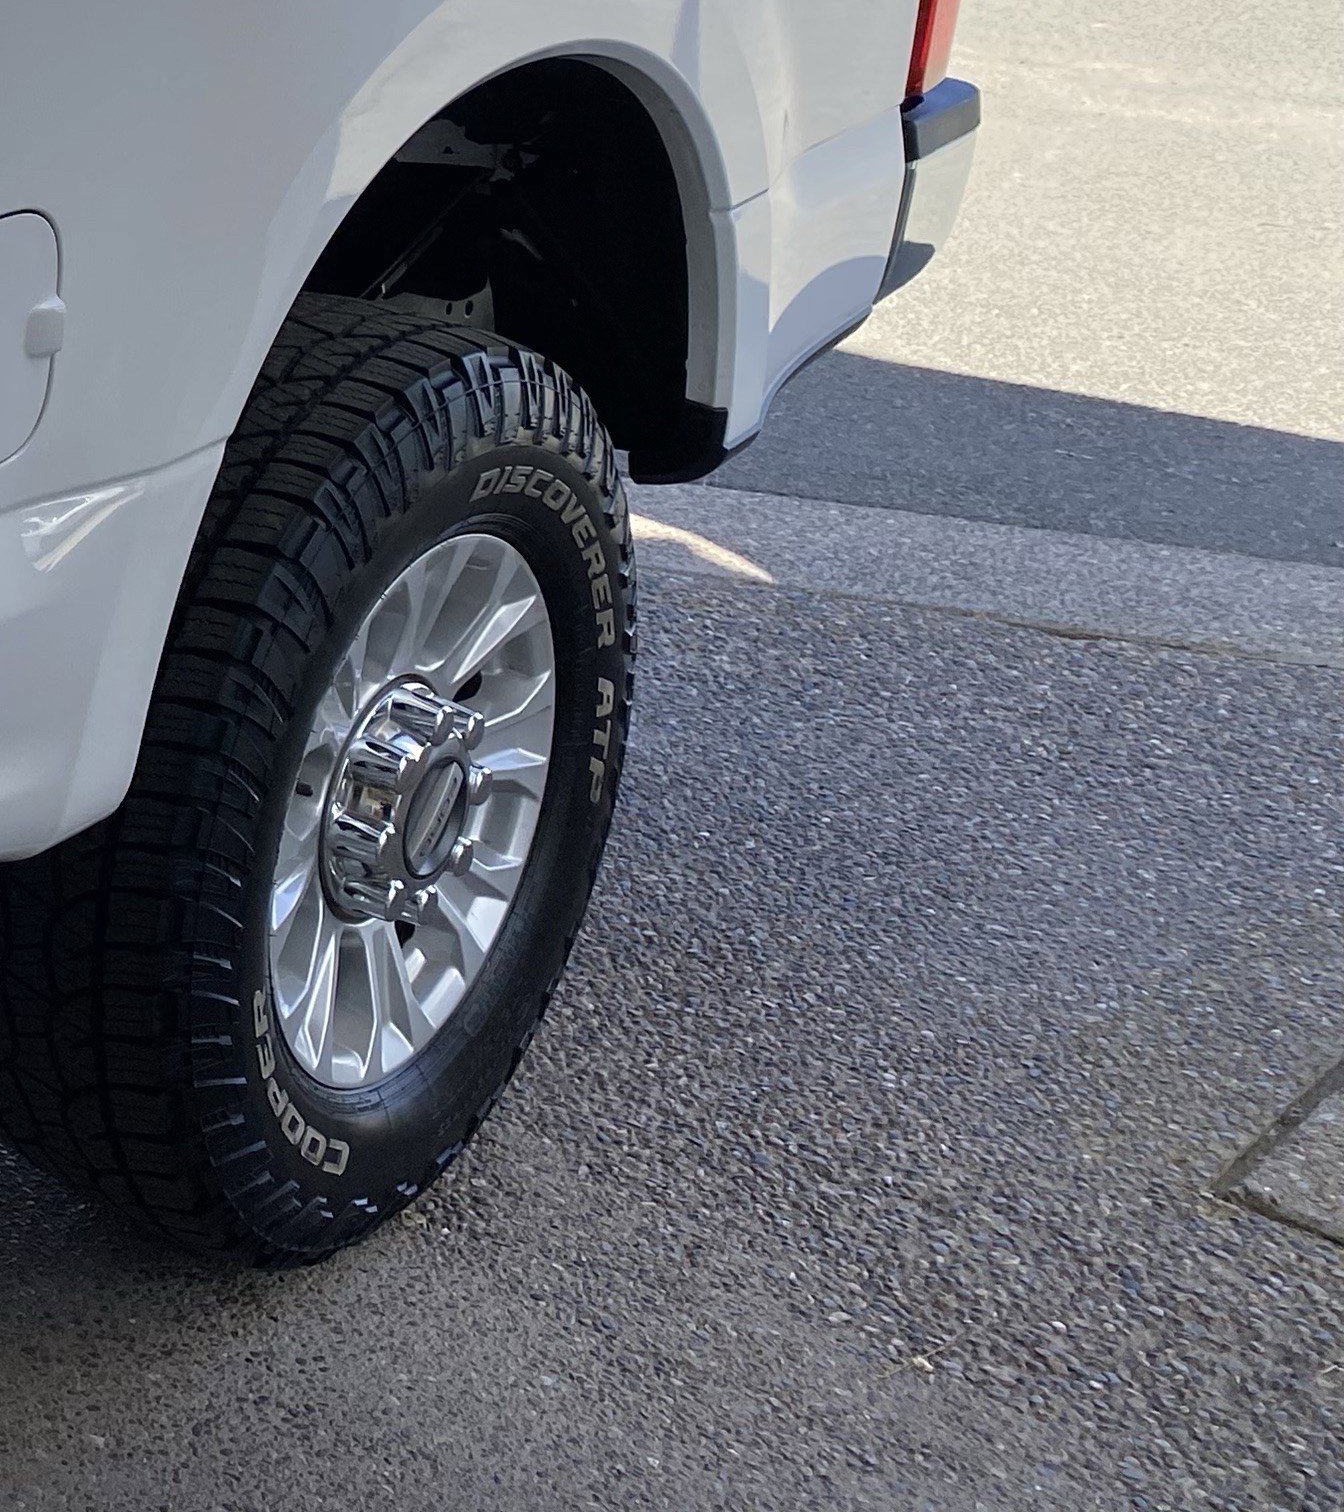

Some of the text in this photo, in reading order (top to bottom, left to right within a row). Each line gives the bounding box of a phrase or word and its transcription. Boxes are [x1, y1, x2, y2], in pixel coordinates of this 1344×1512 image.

[469, 465, 616, 650] DISCOVERER
[589, 677, 615, 804] ATP
[253, 989, 350, 1177] COOPER
